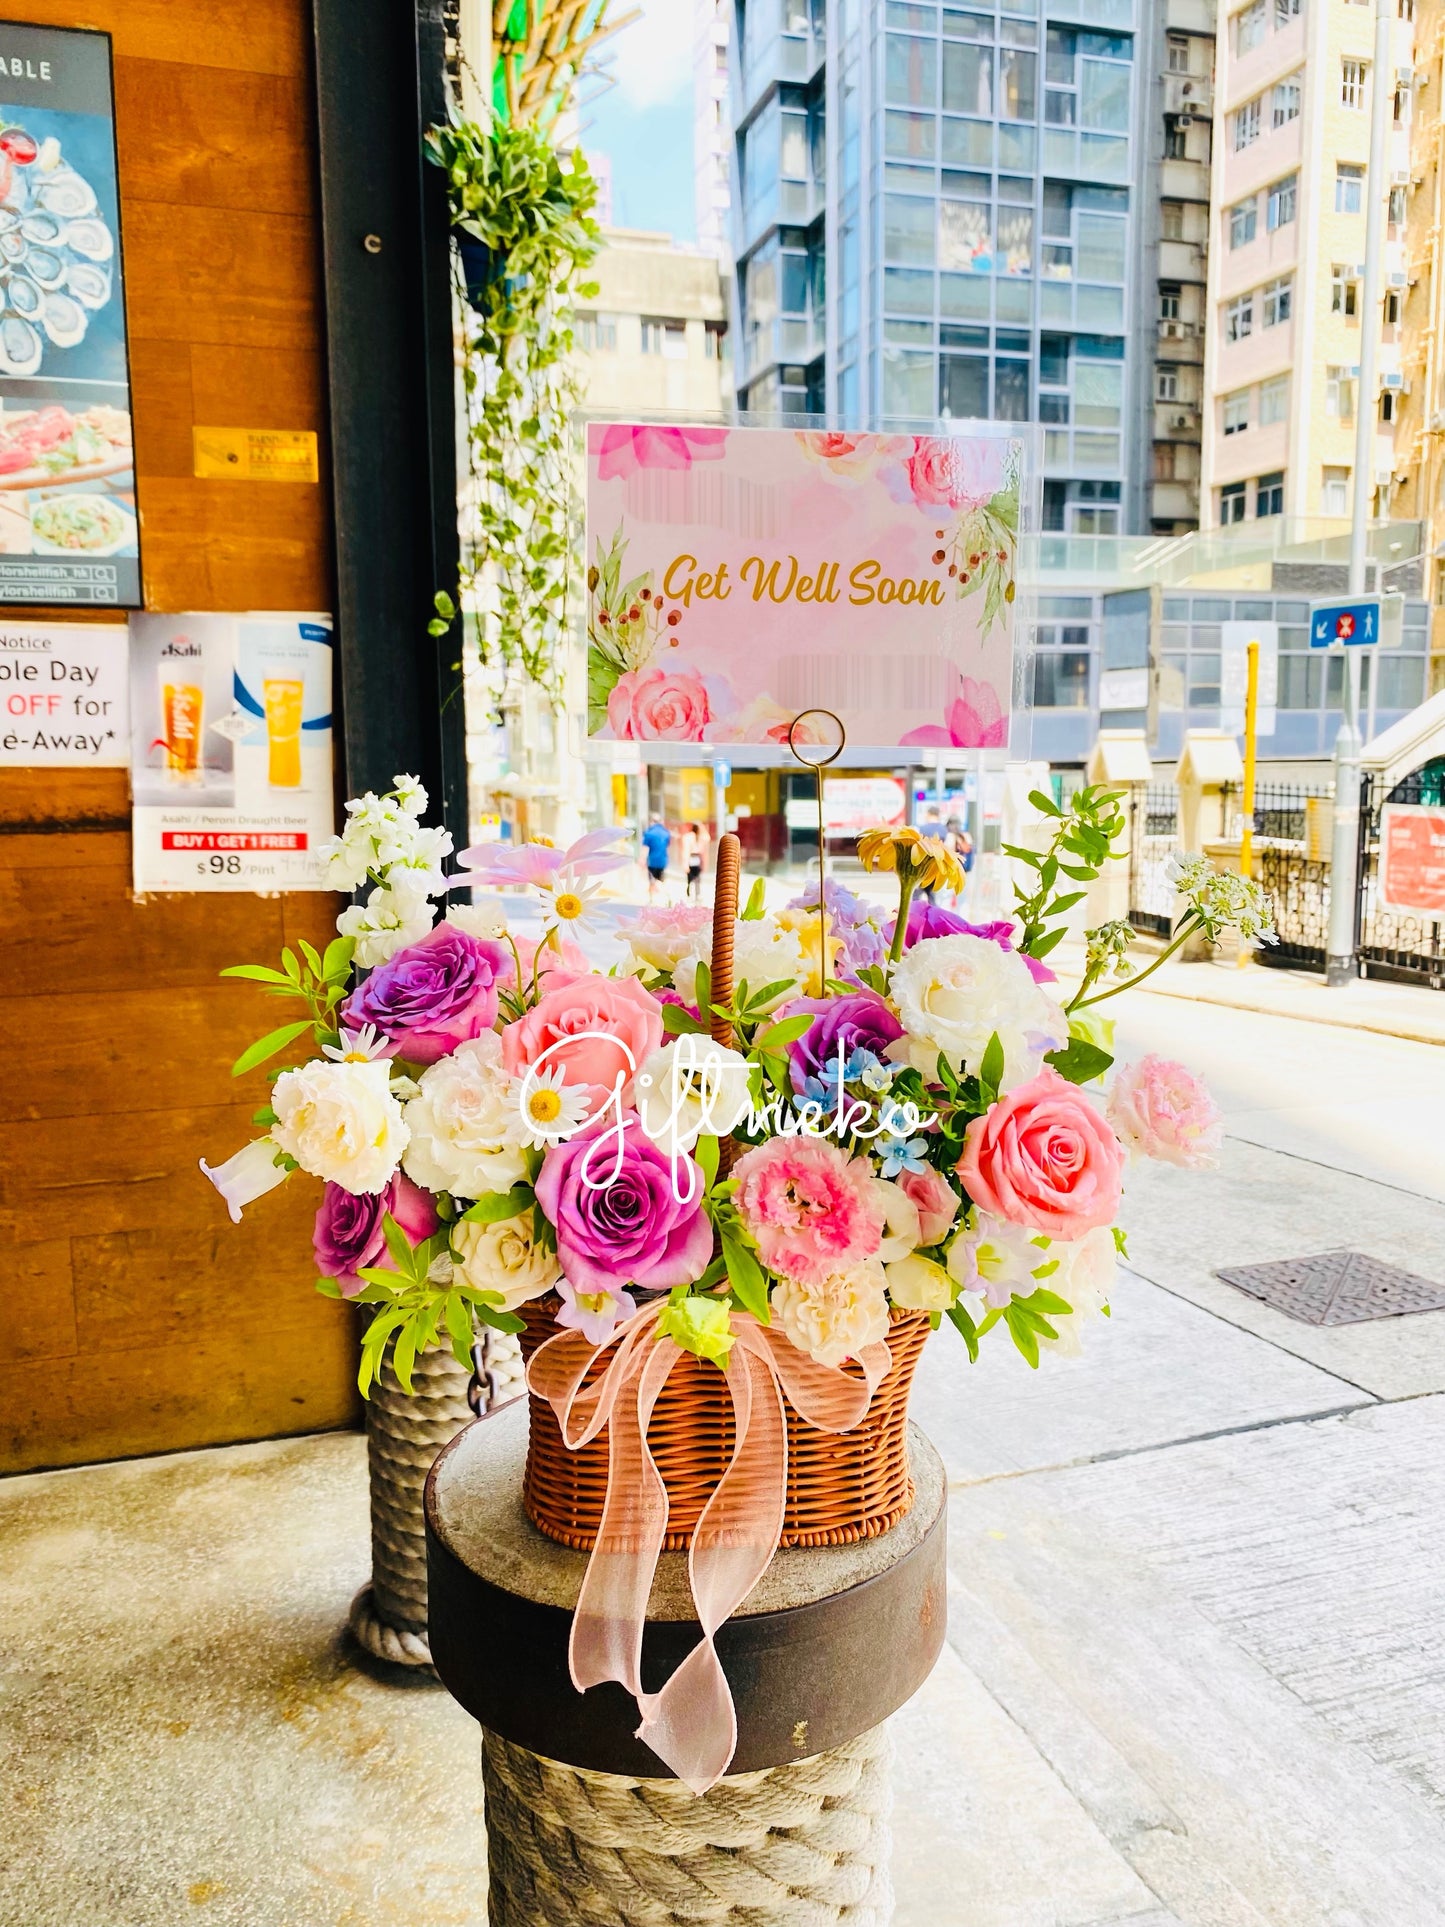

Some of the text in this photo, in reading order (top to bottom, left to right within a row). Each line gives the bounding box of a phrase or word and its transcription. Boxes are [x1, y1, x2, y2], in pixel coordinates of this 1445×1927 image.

[662, 554, 946, 608] Get Well Soon
[161, 643, 202, 657] Asahi
[50, 660, 99, 687] Day
[7, 694, 112, 716] OFF for
[161, 815, 191, 824] Asahi
[202, 815, 236, 825] Peroni
[238, 816, 281, 827] Draught
[284, 816, 308, 825] Beer
[173, 835, 297, 849] BUY 1 GET 1 FREE
